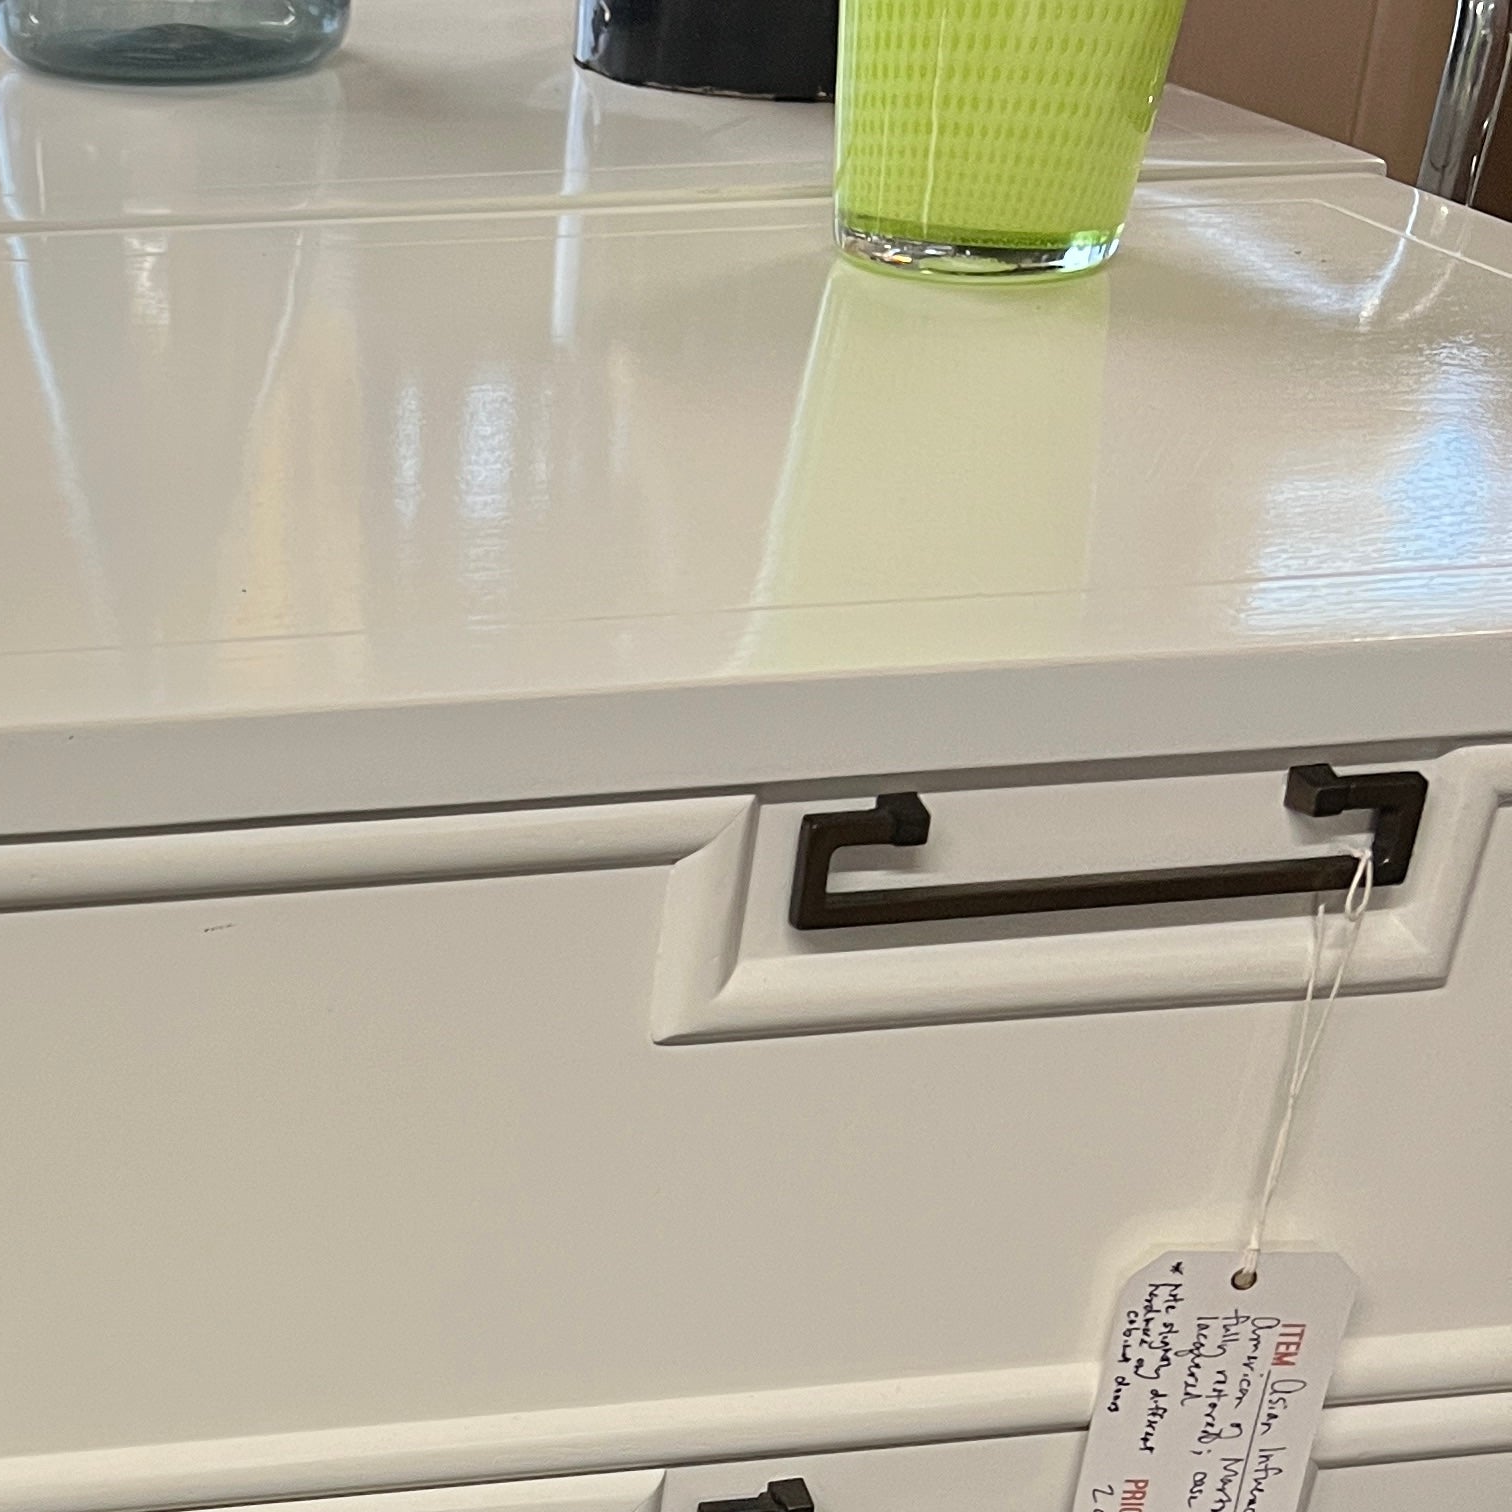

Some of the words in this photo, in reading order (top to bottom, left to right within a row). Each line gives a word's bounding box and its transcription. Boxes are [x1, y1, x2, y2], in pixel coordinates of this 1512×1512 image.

[1198, 1309, 1250, 1358] fully
[1271, 1324, 1306, 1366] ITEM
[1174, 1316, 1219, 1406] lacquered
[1234, 1317, 1280, 1409] American
[1092, 1485, 1114, 1502] 2
